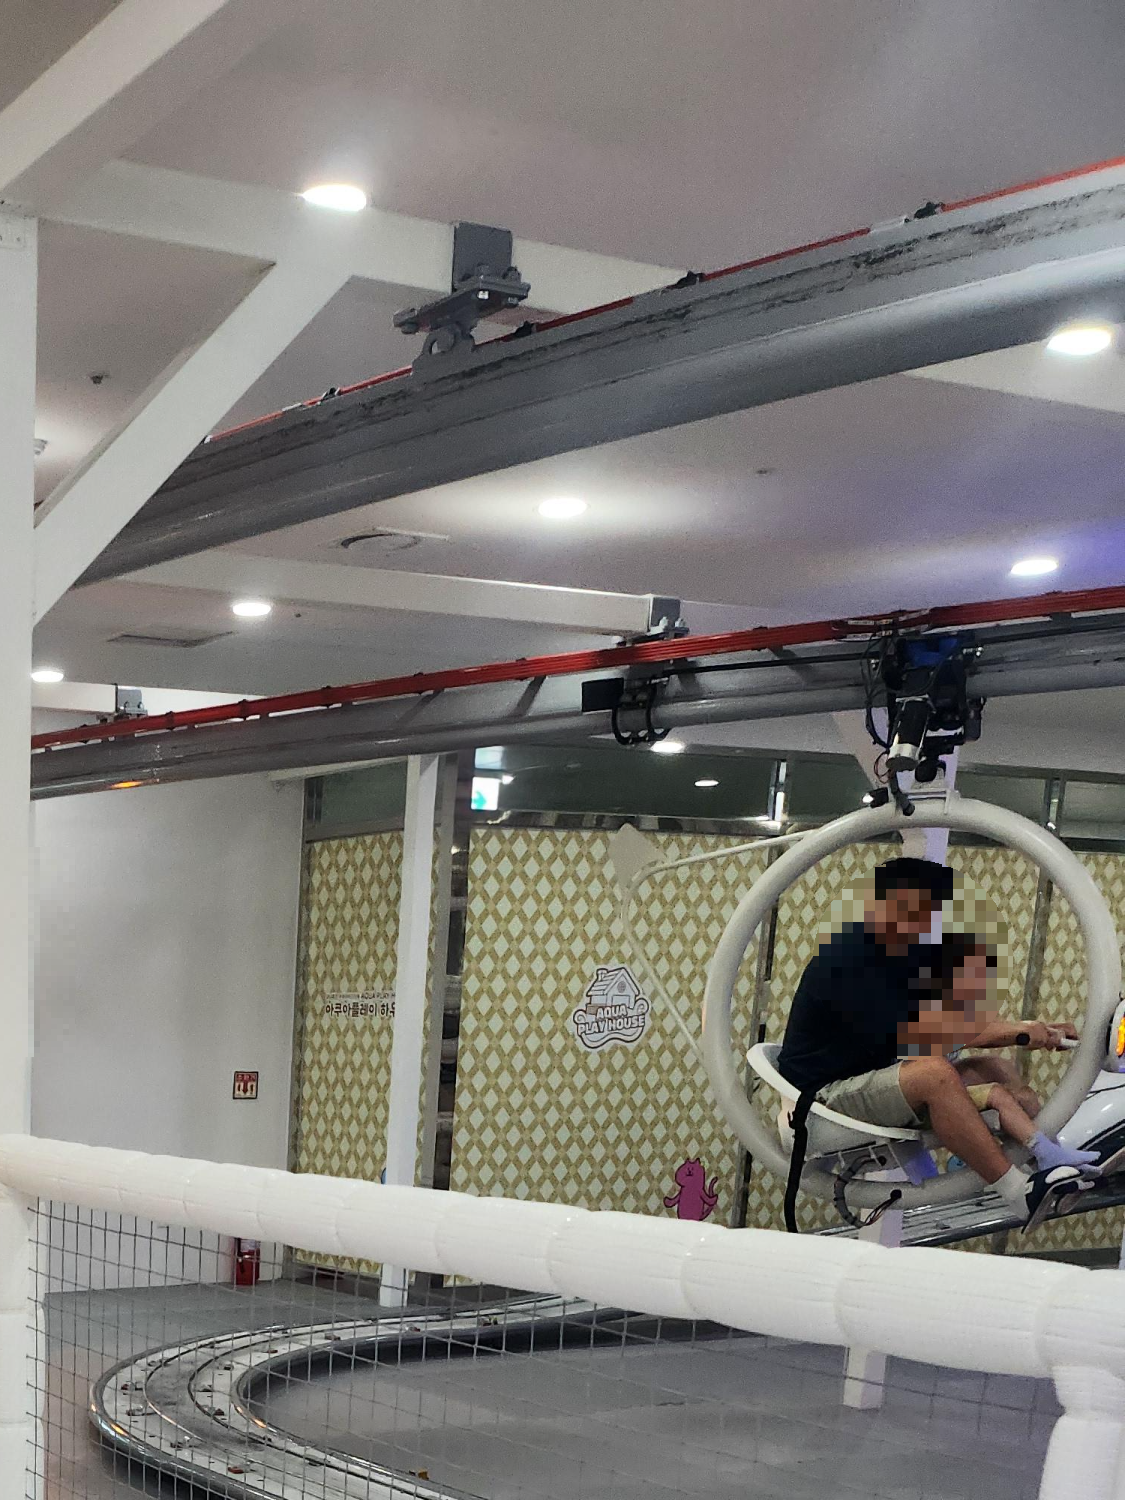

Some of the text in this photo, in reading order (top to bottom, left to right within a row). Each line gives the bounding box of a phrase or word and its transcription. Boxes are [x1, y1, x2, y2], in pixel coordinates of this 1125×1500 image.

[326, 1002, 395, 1017] 아쿠아플레이 하우
[596, 1005, 627, 1019] AQUA
[578, 1015, 645, 1035] PLAY HOUSE
